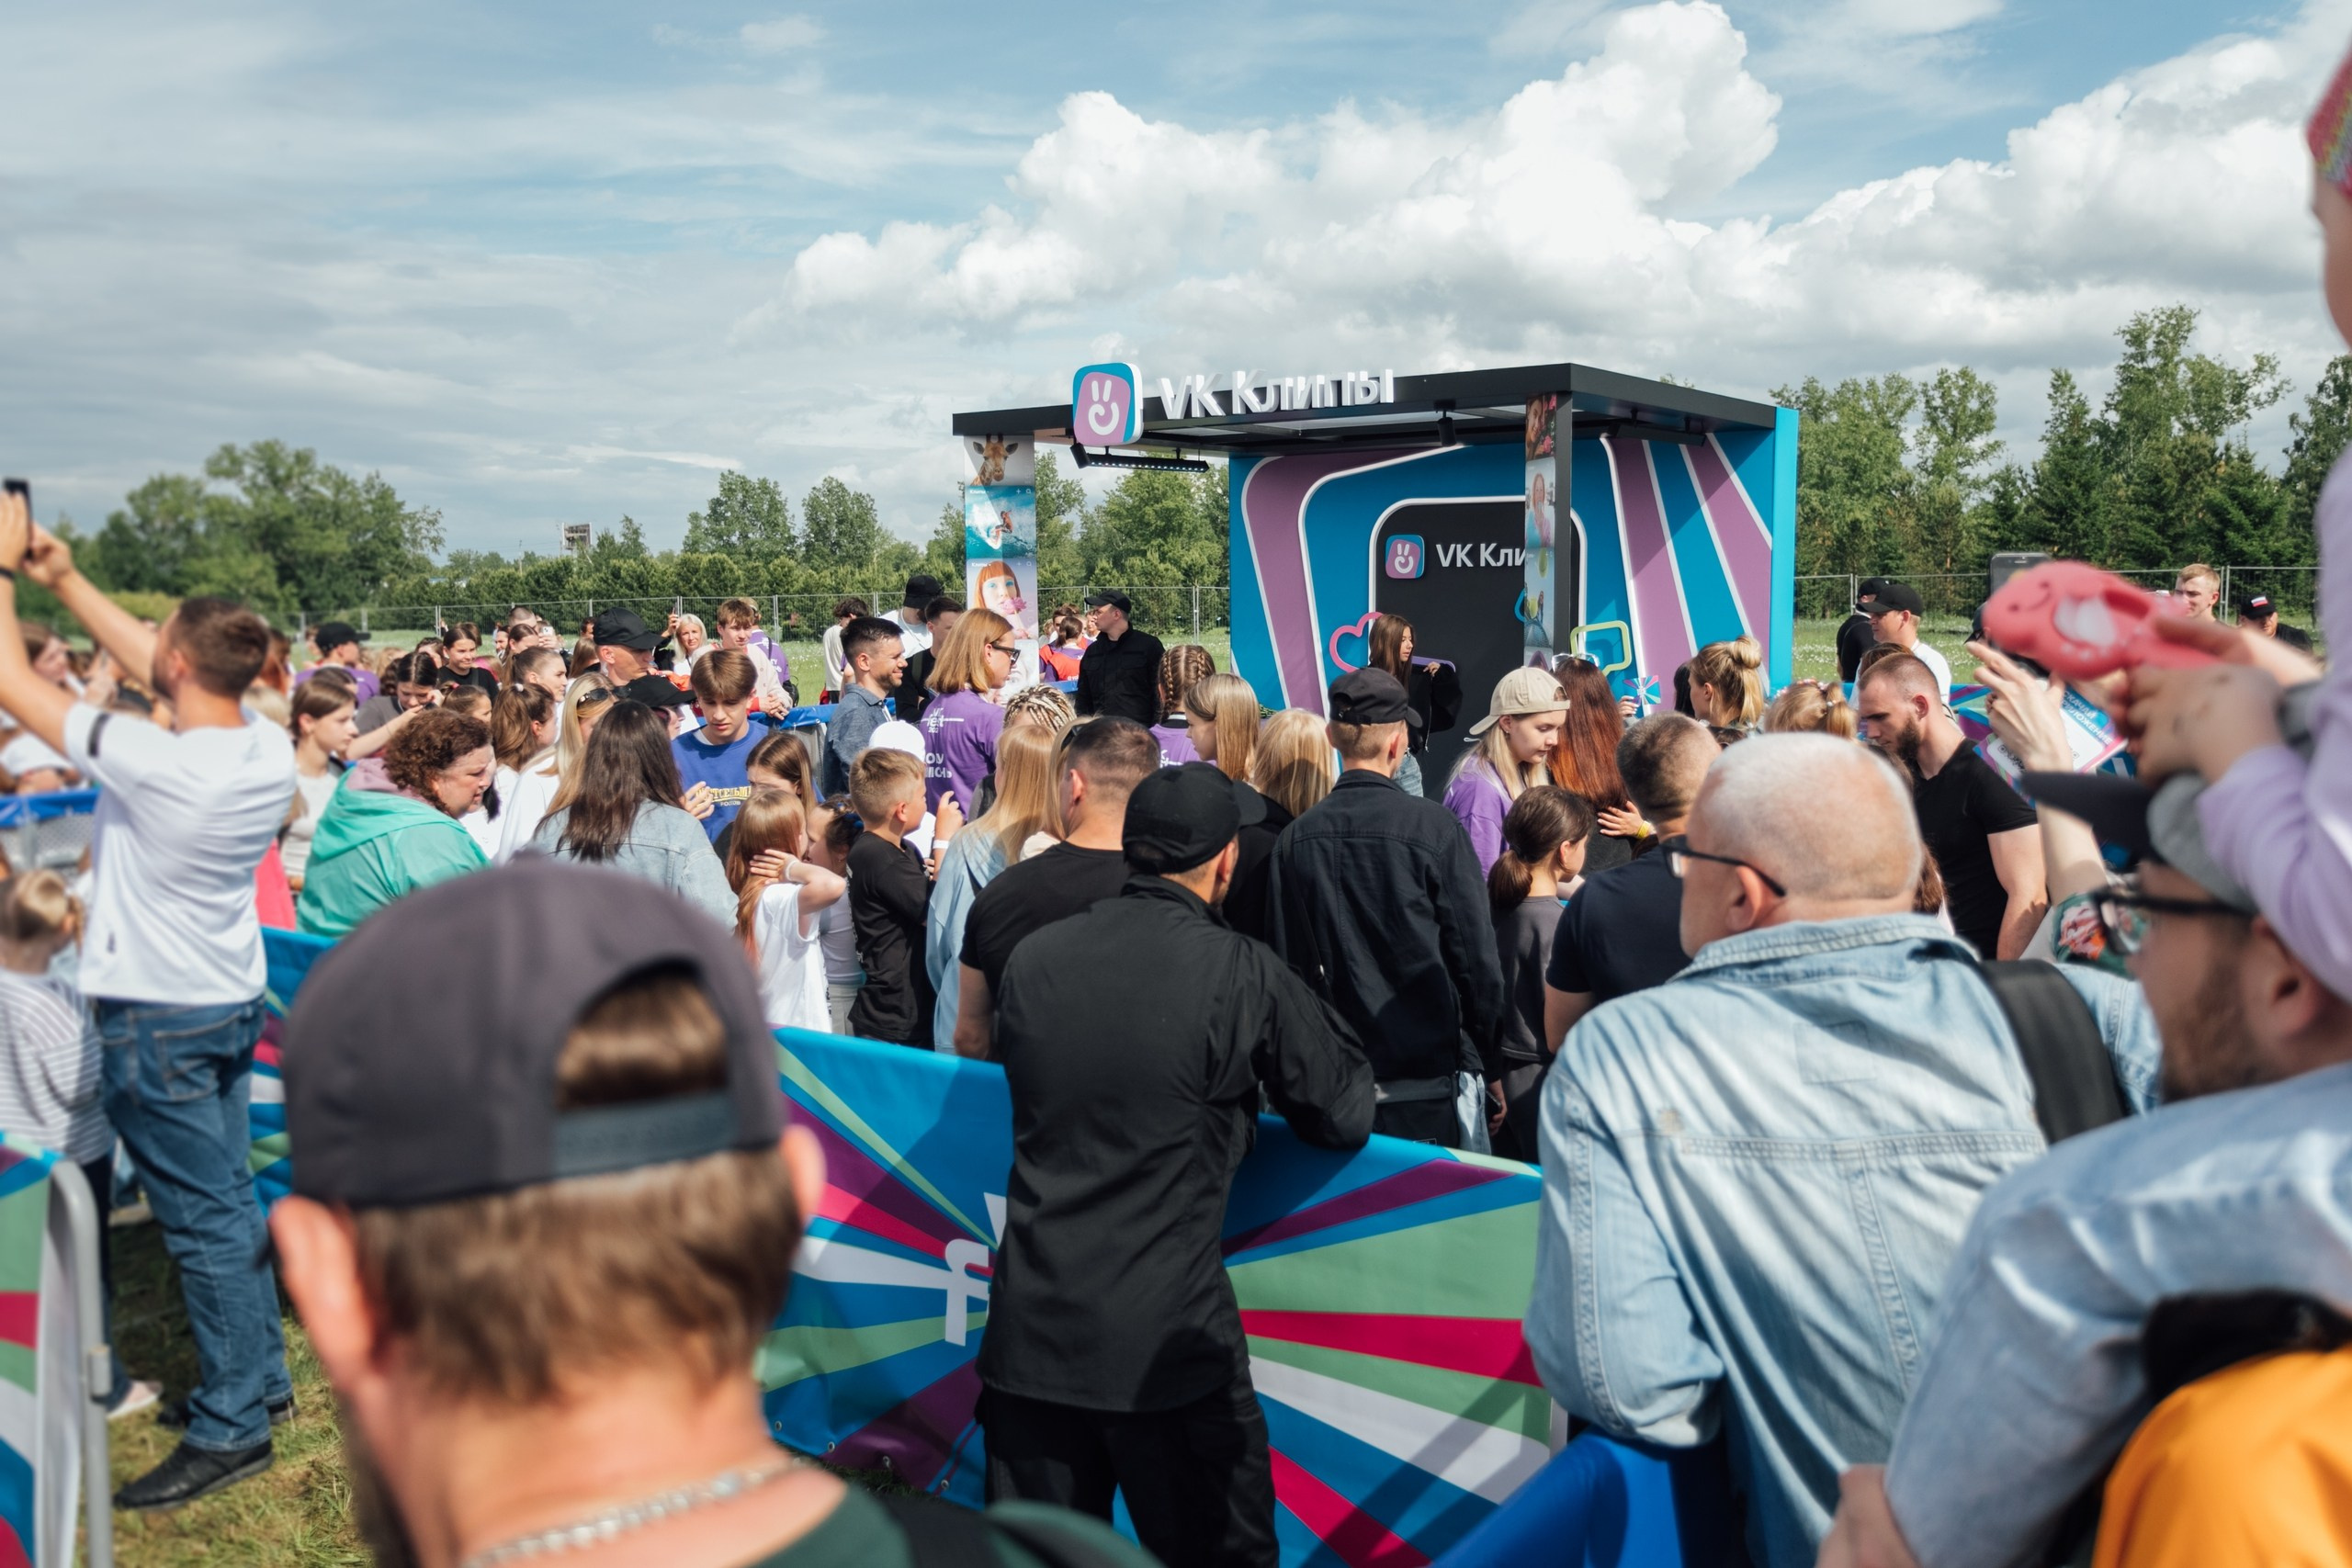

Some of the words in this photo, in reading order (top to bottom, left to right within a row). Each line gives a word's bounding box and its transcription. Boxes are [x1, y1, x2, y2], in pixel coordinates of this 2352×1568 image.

[1158, 373, 1226, 420] VK
[1232, 369, 1394, 414] Клипы
[1436, 544, 1474, 567] VK
[1480, 543, 1525, 567] Кли
[2061, 699, 2112, 745] РИЛОЖЕНИЕ
